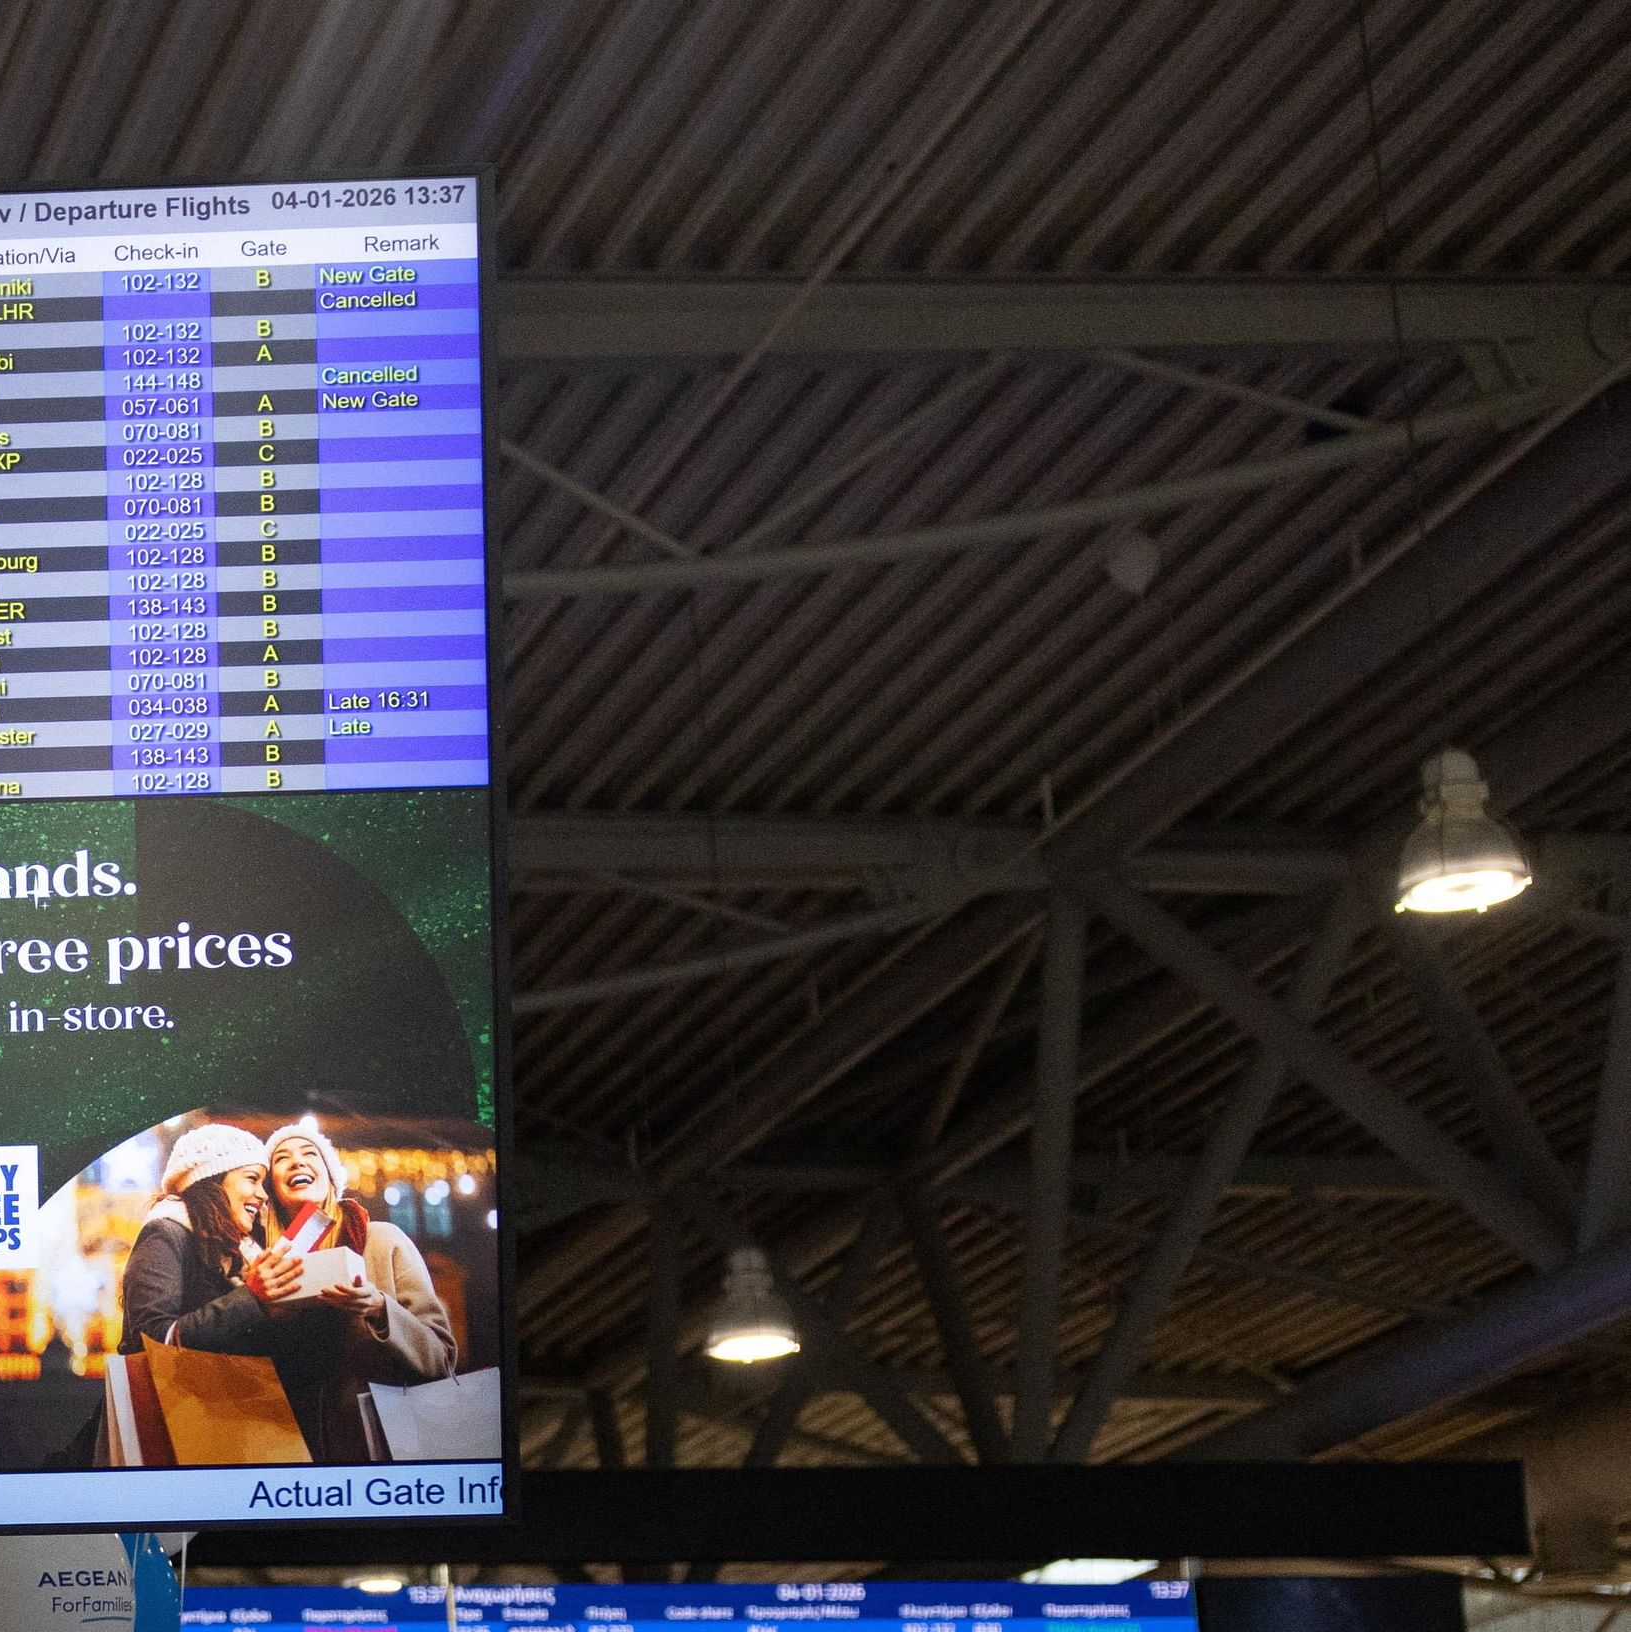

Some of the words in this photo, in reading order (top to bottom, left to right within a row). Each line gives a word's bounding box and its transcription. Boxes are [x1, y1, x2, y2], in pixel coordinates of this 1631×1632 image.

[18, 203, 28, 224] /
[35, 199, 158, 225] Departure
[166, 196, 250, 223] Flights
[271, 187, 396, 210] 04-01-2026
[404, 185, 465, 206] 13:37
[114, 240, 199, 263] Check-in
[241, 238, 286, 258] Gate
[364, 232, 440, 254] Remark
[120, 271, 199, 292] 102-132
[256, 270, 270, 288] B
[319, 266, 358, 285] New
[366, 264, 415, 284] Gate
[128, 695, 208, 716] 034-038
[263, 695, 279, 713] A
[328, 692, 370, 711] Late
[378, 690, 429, 710] 16:31
[107, 922, 293, 984] prices
[10, 1001, 175, 1034] in-store.
[249, 1479, 352, 1509] Actual
[364, 1478, 445, 1507] Gate
[39, 1570, 127, 1587] AEGEAN
[51, 1595, 132, 1614] ForFamilies
